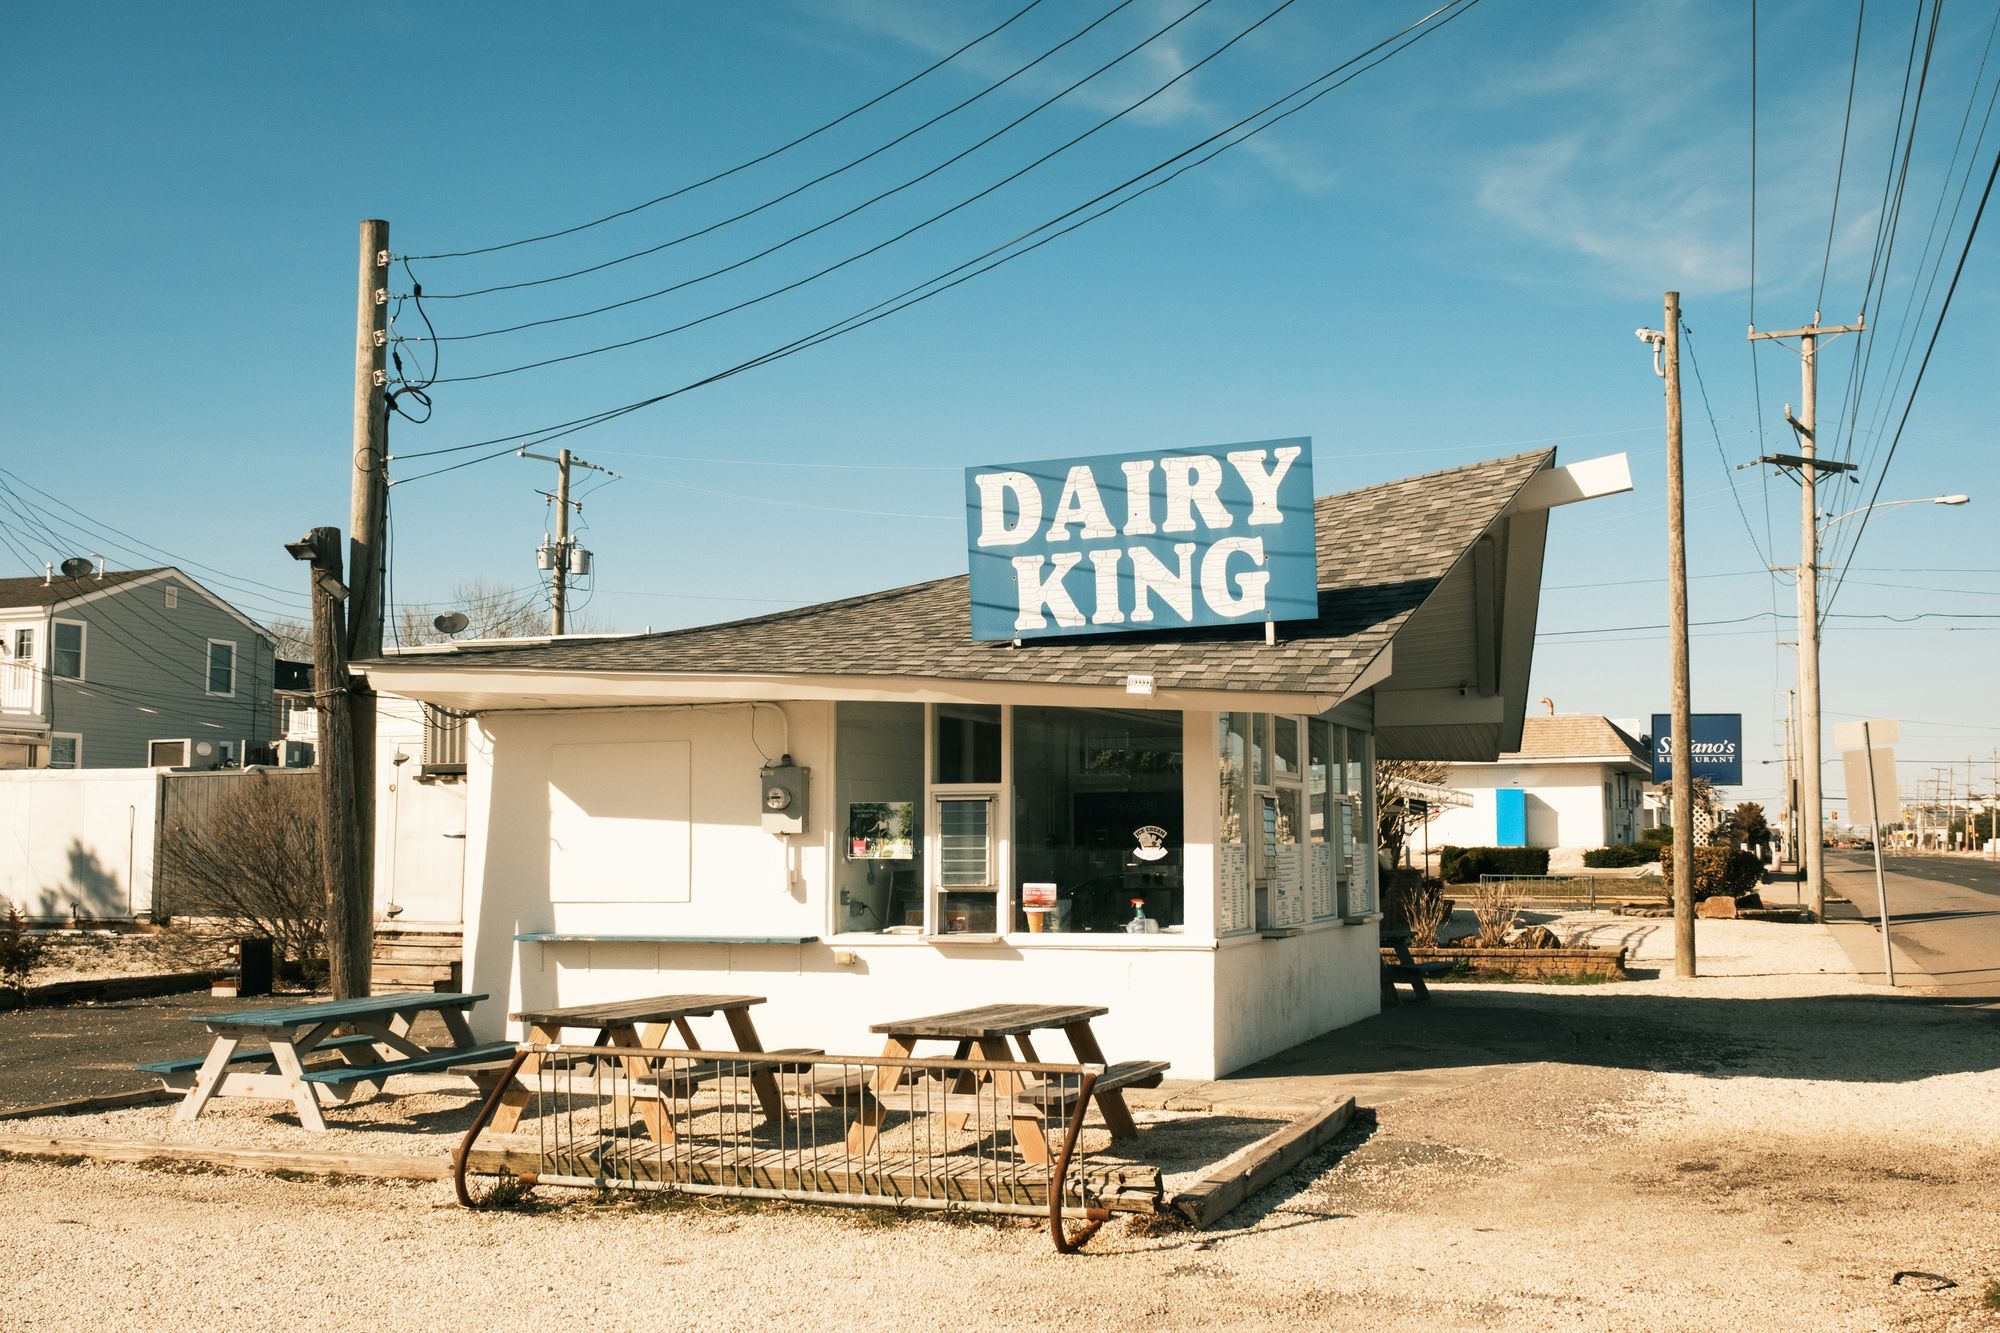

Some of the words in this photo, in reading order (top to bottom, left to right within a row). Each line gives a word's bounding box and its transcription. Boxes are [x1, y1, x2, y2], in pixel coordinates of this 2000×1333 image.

[975, 446, 1301, 547] DAIRY
[1012, 536, 1270, 630] KING
[1135, 828, 1145, 837] ICE
[1146, 827, 1165, 836] CREAM
